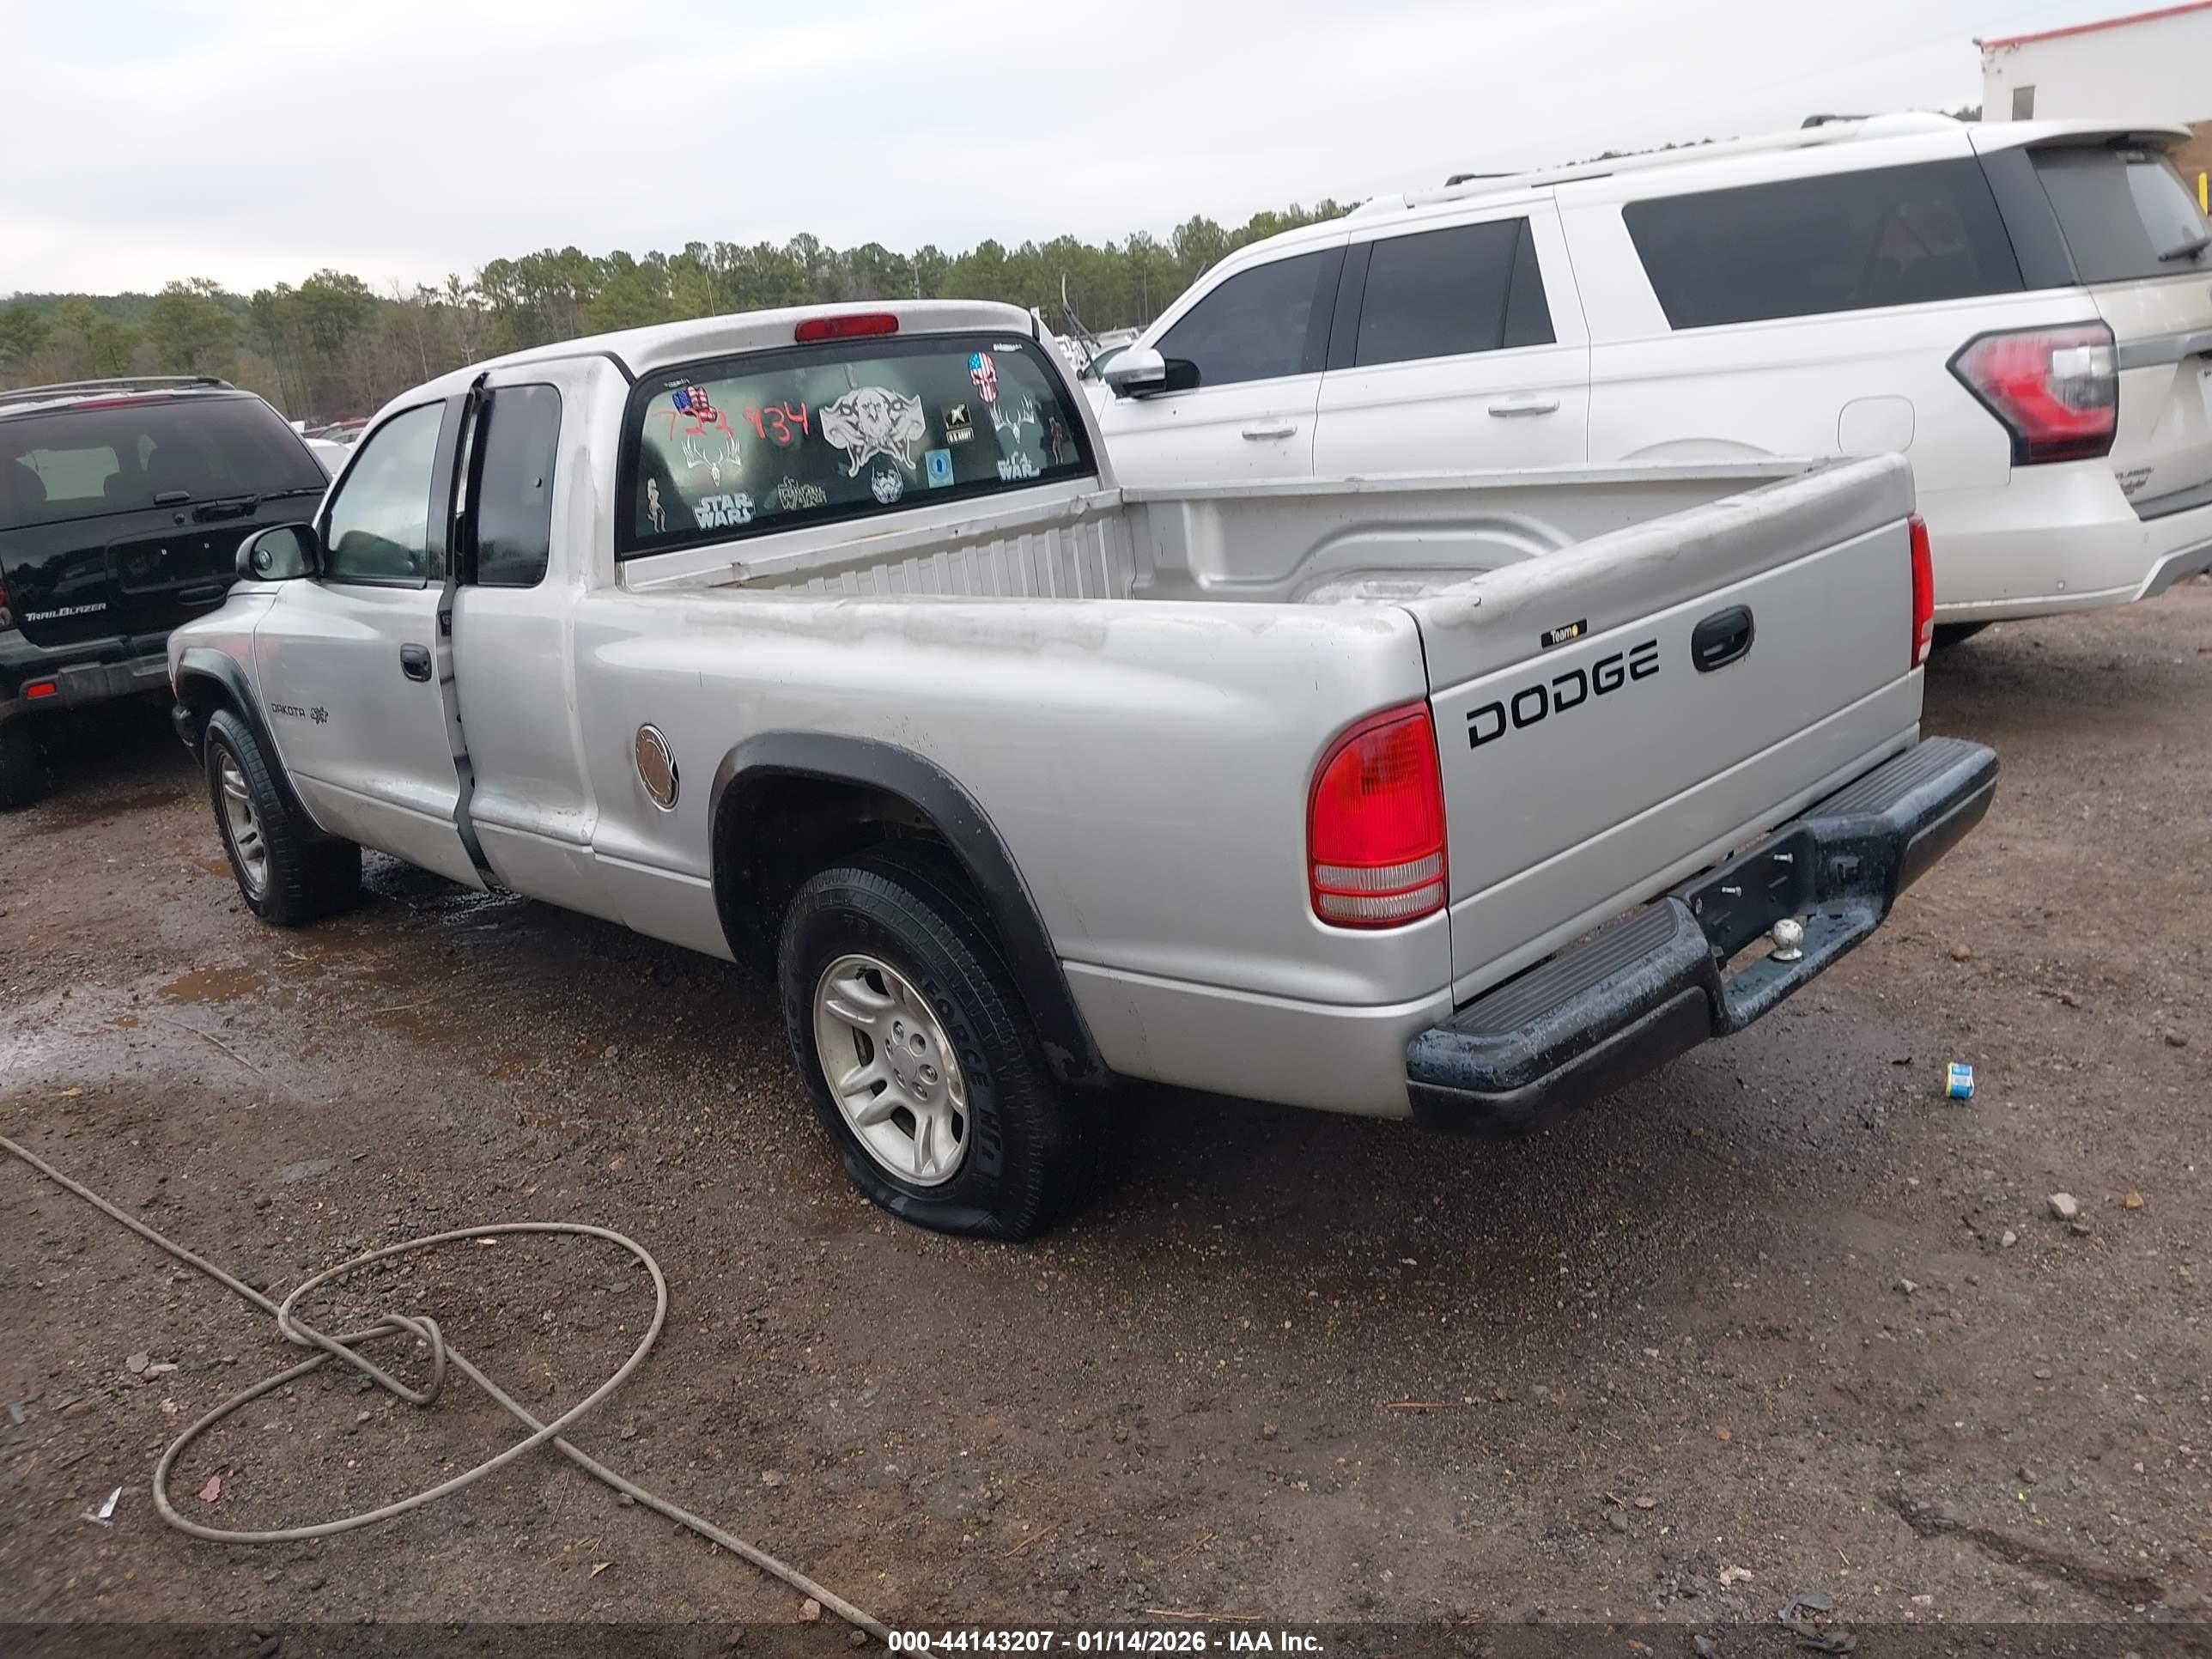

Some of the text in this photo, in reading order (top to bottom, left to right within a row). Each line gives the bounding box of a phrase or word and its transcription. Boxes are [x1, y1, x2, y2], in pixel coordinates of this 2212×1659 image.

[700, 492, 753, 514] STAR
[694, 506, 753, 531] WARS
[1466, 639, 1660, 749] DODGE
[270, 702, 306, 719] DAKOTA
